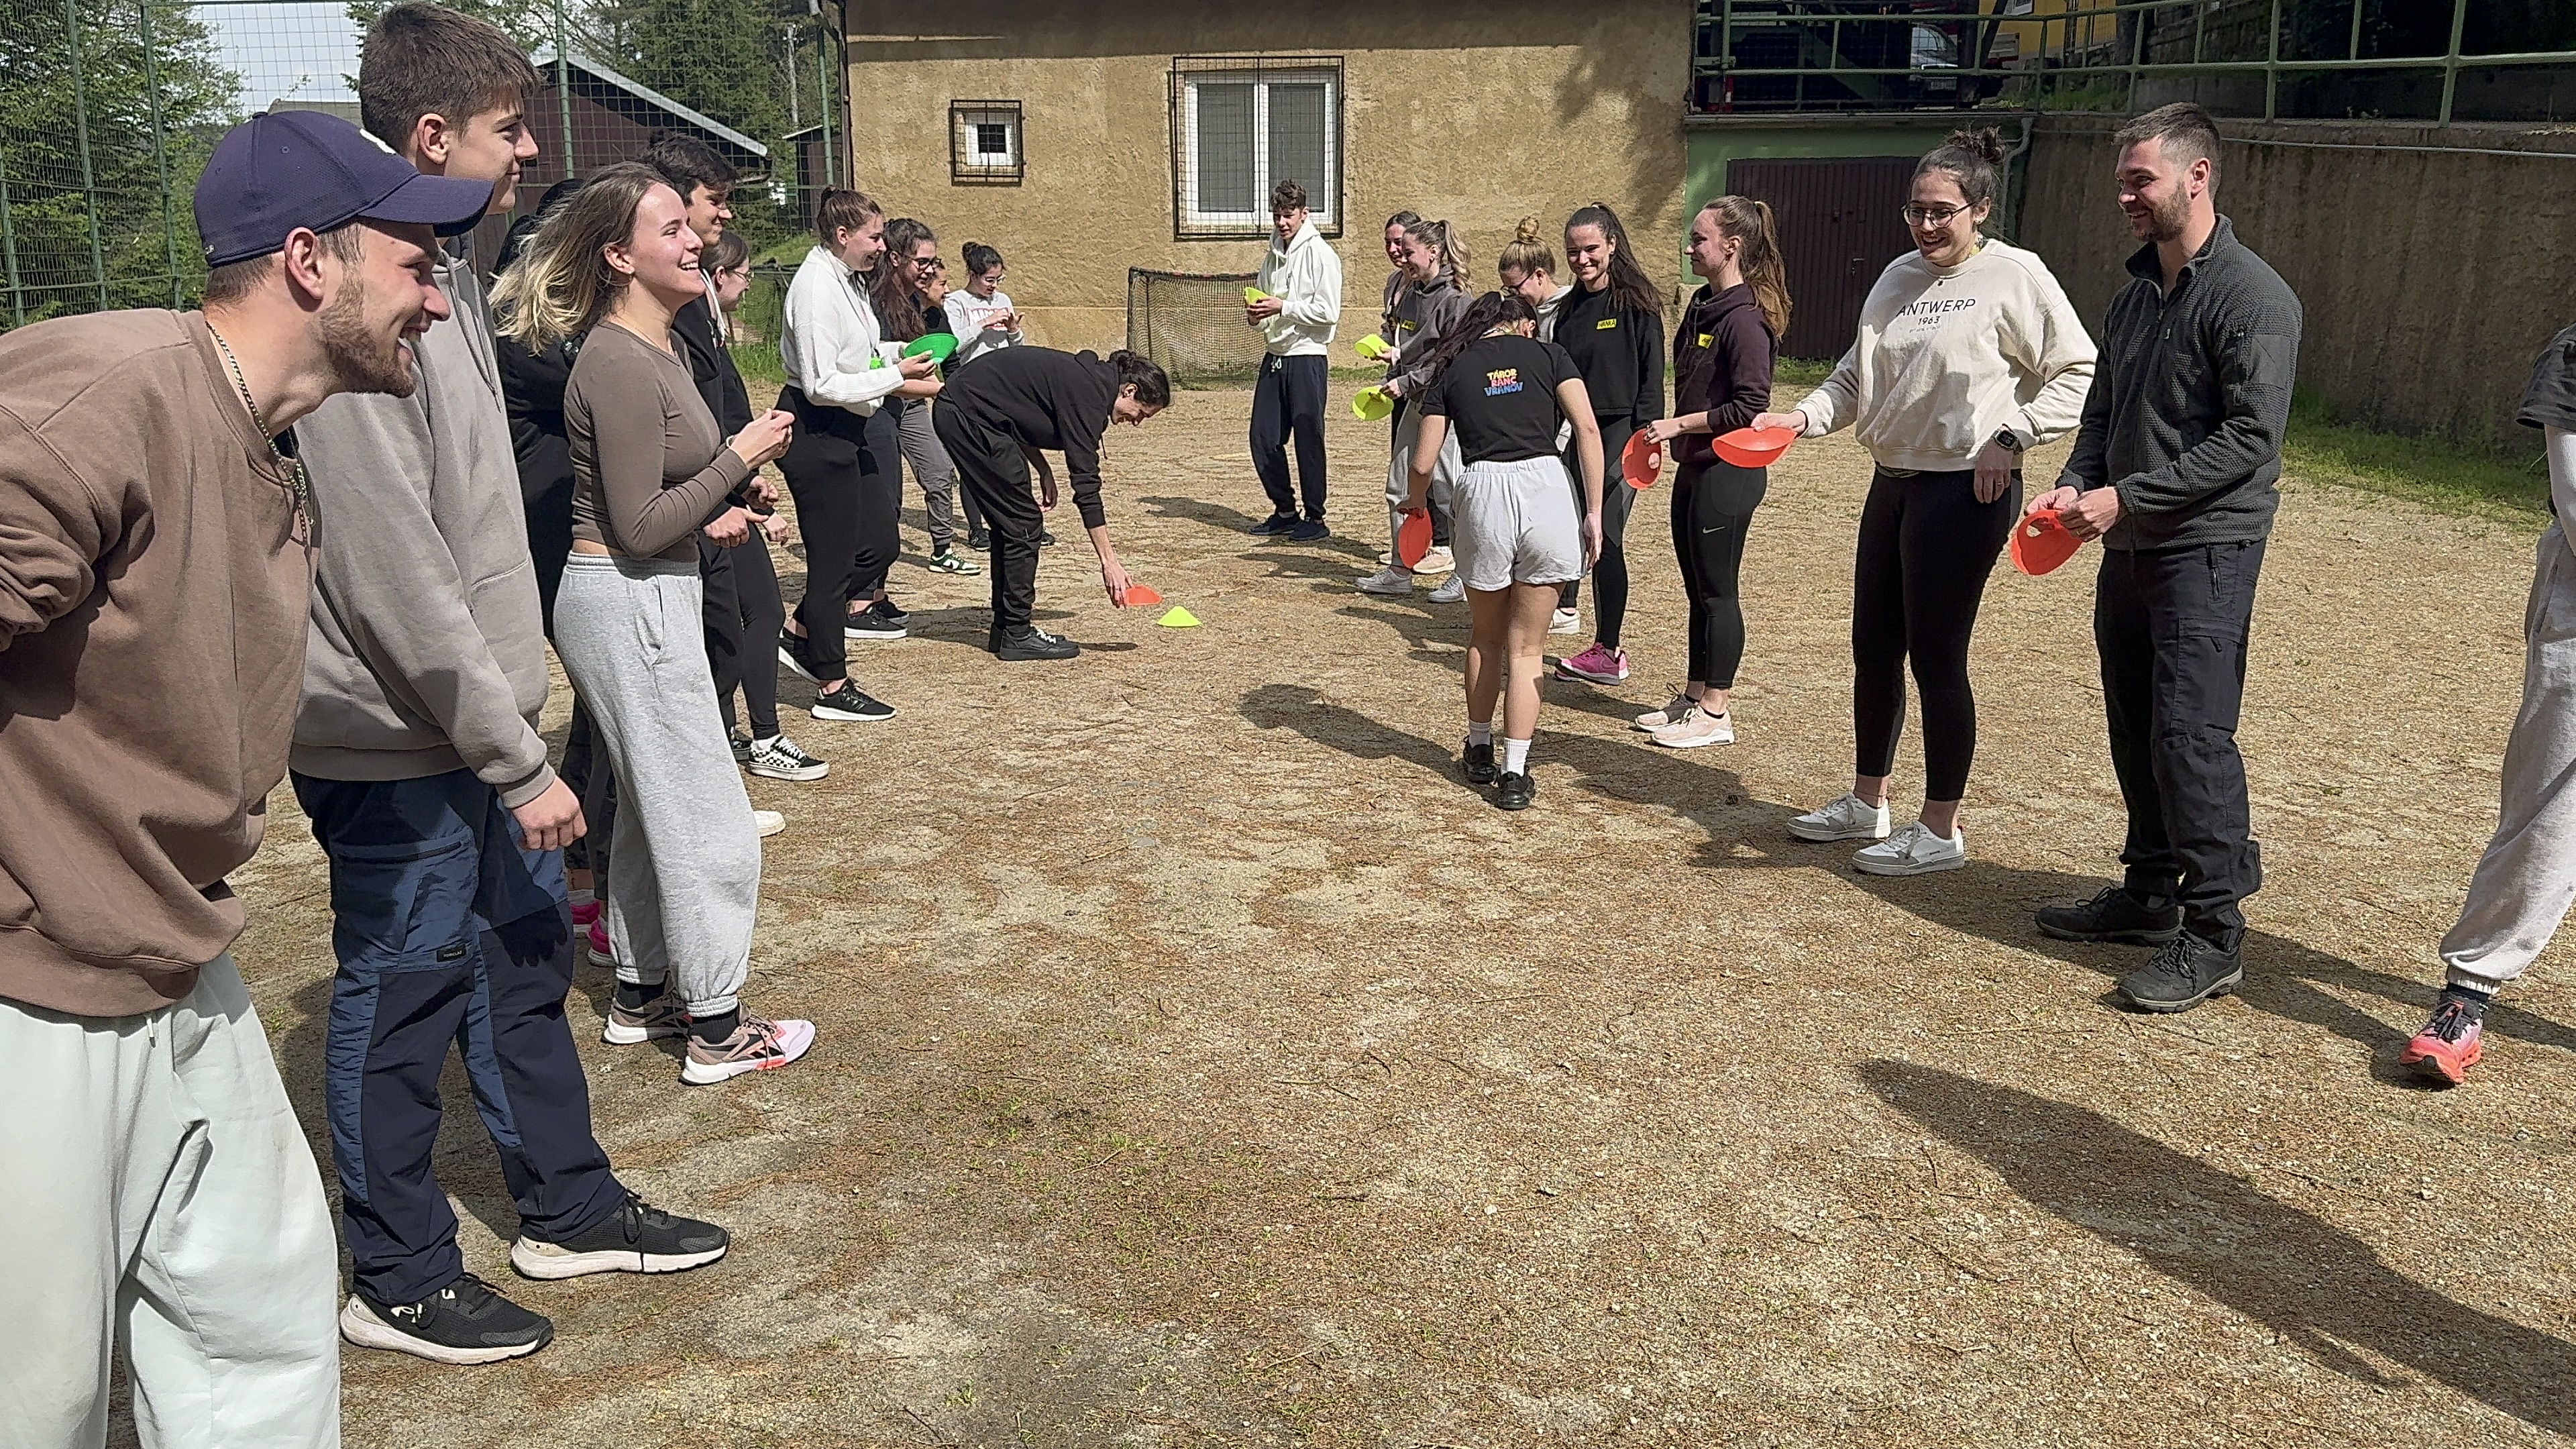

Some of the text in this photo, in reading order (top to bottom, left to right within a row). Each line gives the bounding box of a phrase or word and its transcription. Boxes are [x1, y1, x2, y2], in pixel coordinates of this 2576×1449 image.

[1896, 299, 1976, 317] ANTWERP
[1918, 316, 1941, 325] 1963
[1487, 368, 1517, 380] TÁBOR
[1484, 382, 1523, 396] VRANOV
